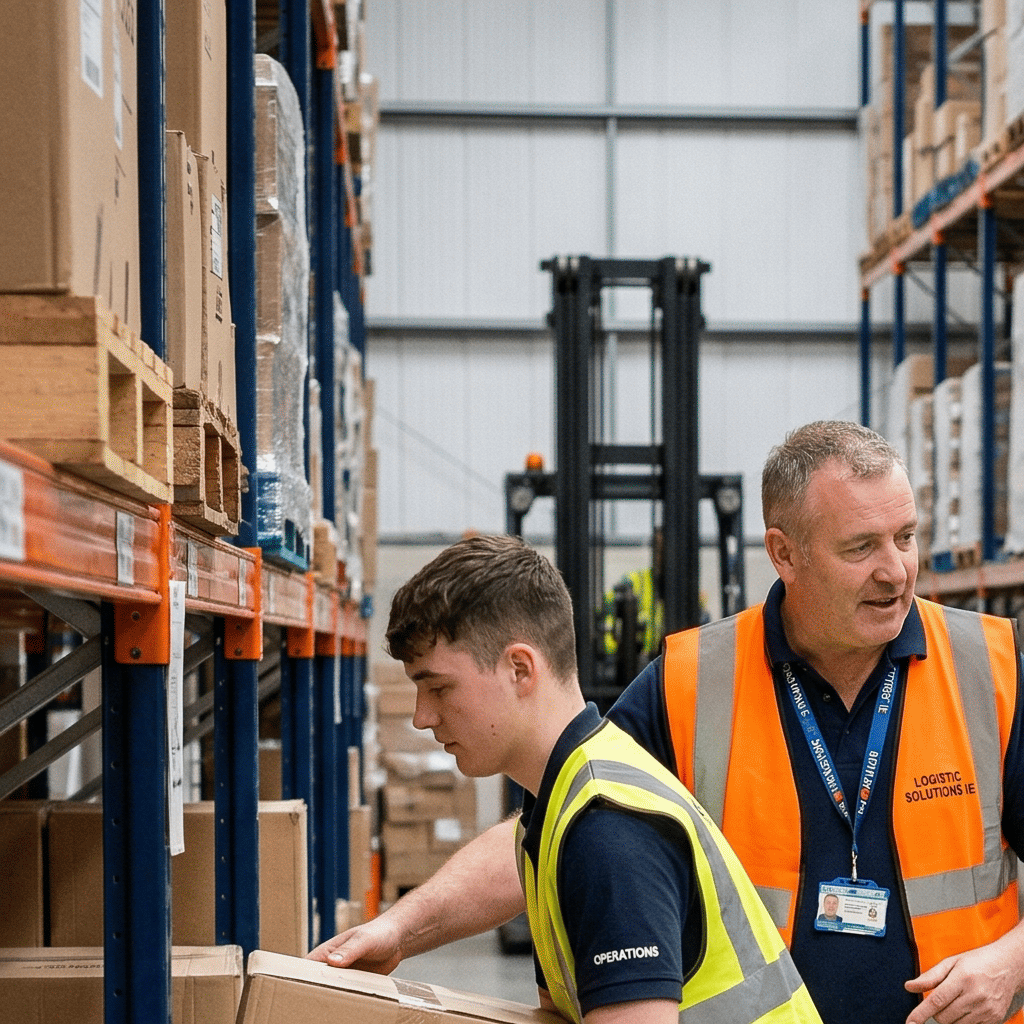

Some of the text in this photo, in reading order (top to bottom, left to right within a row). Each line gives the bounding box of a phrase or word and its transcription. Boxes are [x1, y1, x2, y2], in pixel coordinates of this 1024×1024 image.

[914, 771, 961, 788] LOGISTIC
[905, 783, 976, 803] SOLUTIONS IE
[593, 945, 659, 965] OPERATIONS
